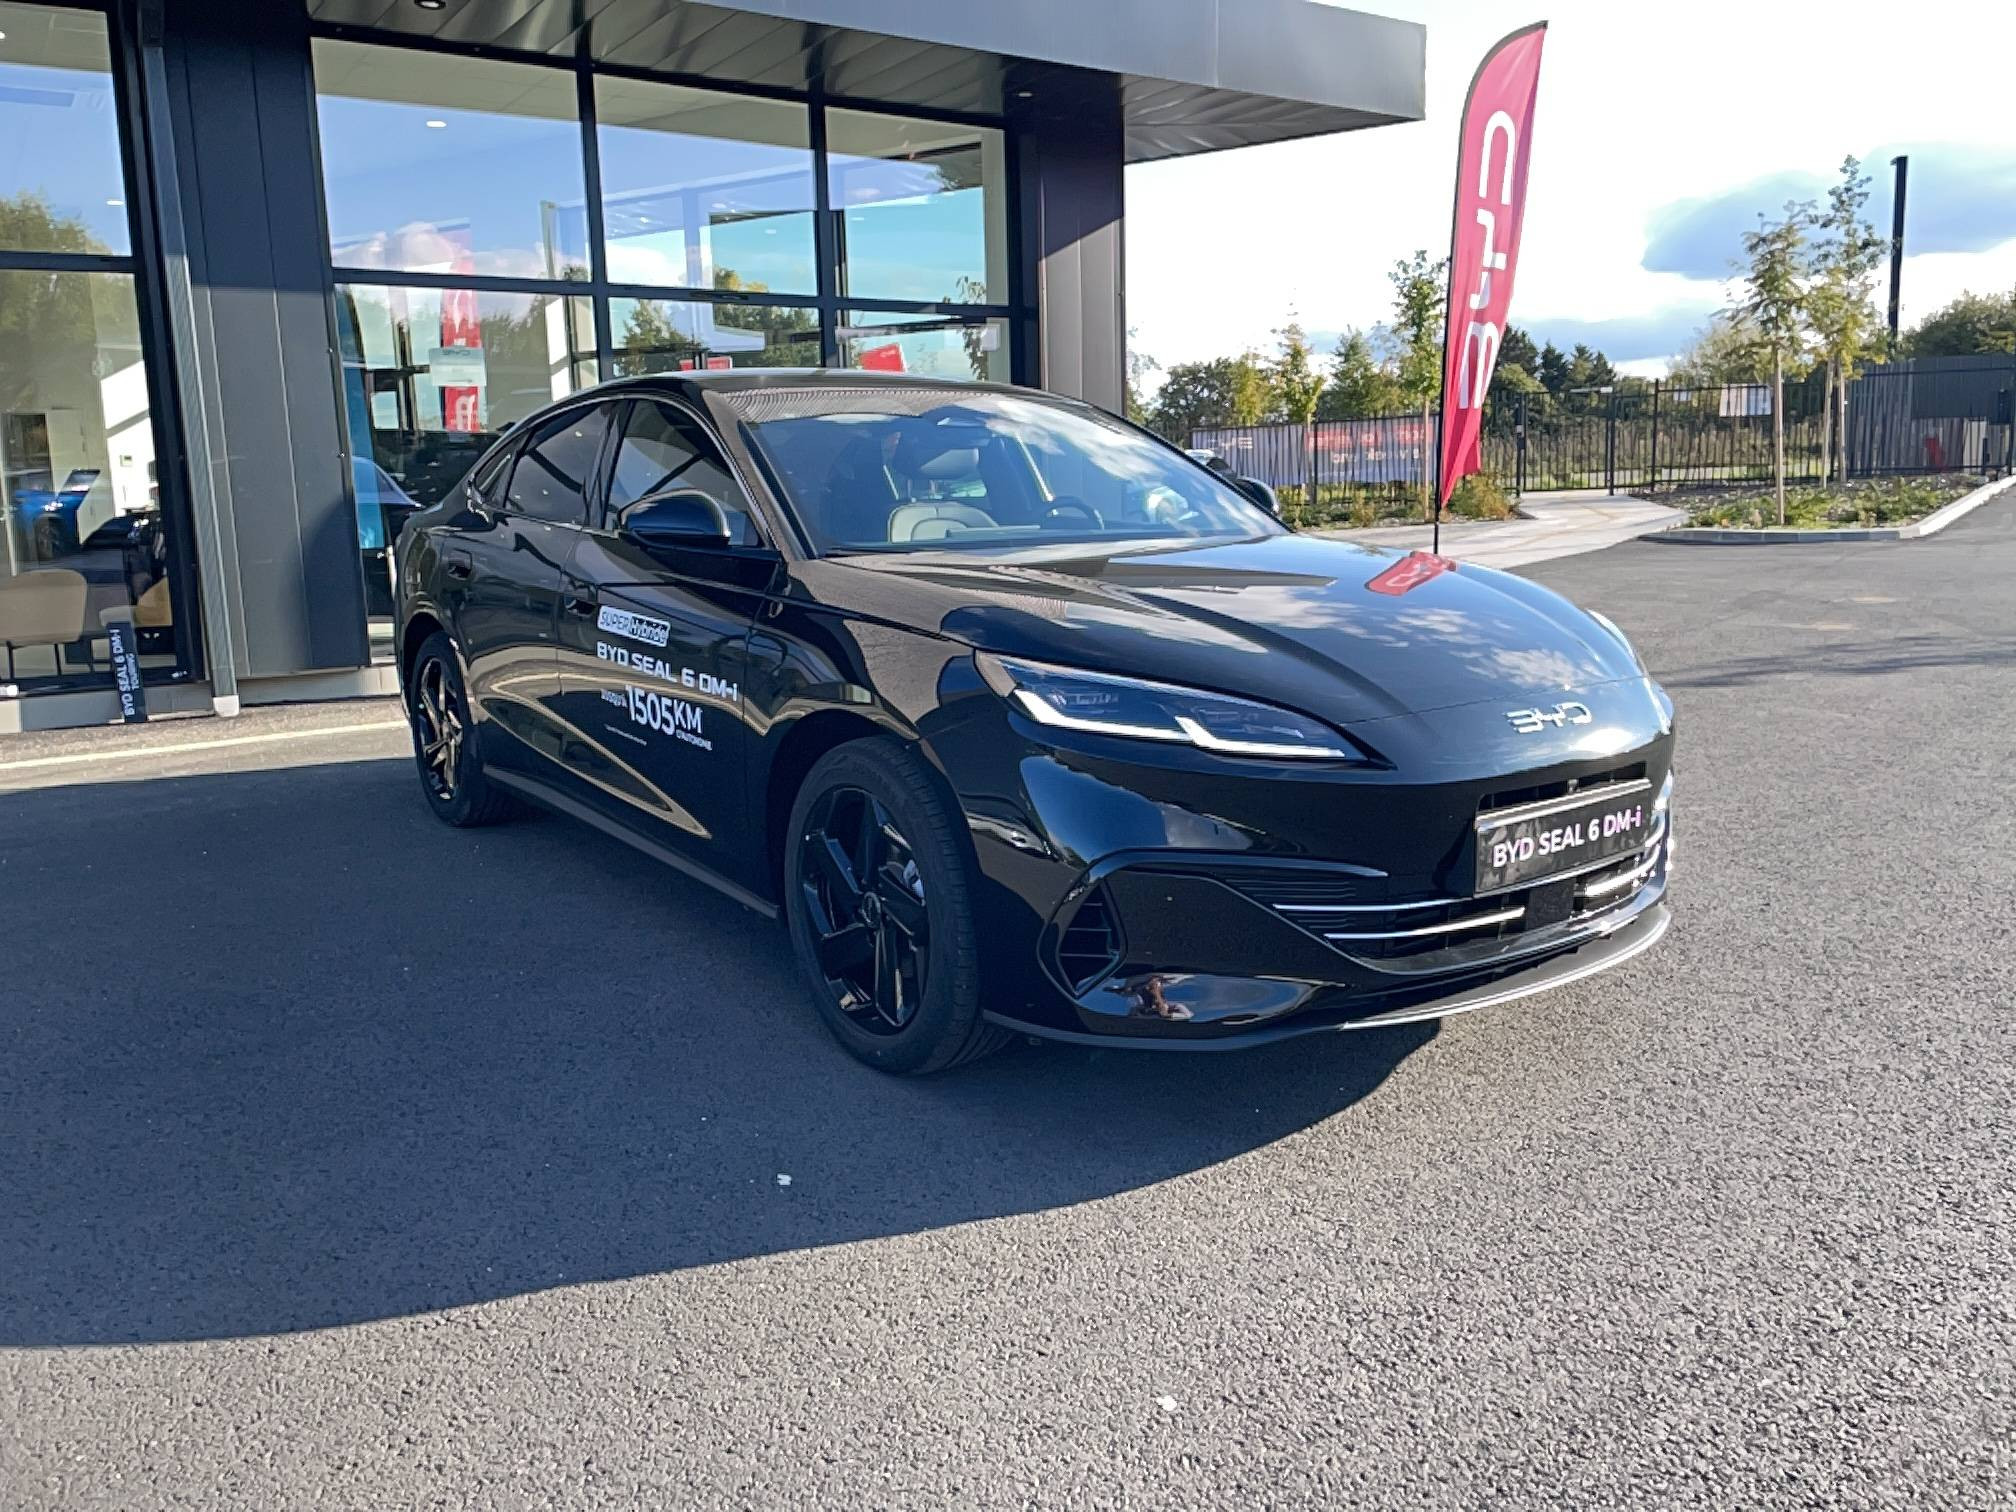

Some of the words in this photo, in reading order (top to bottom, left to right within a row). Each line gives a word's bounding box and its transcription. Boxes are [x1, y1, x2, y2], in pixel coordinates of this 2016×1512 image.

[1458, 110, 1516, 409] BYD
[114, 655, 125, 664] 6
[596, 641, 629, 667] BYD
[631, 652, 679, 683] SEAL
[680, 667, 696, 688] 6
[122, 692, 135, 716] BYD
[1502, 702, 1593, 734] BYD
[1492, 837, 1535, 868] BYD
[1537, 822, 1586, 856] SEAL
[1587, 818, 1601, 842] 6
[1602, 804, 1642, 838] DM-i
